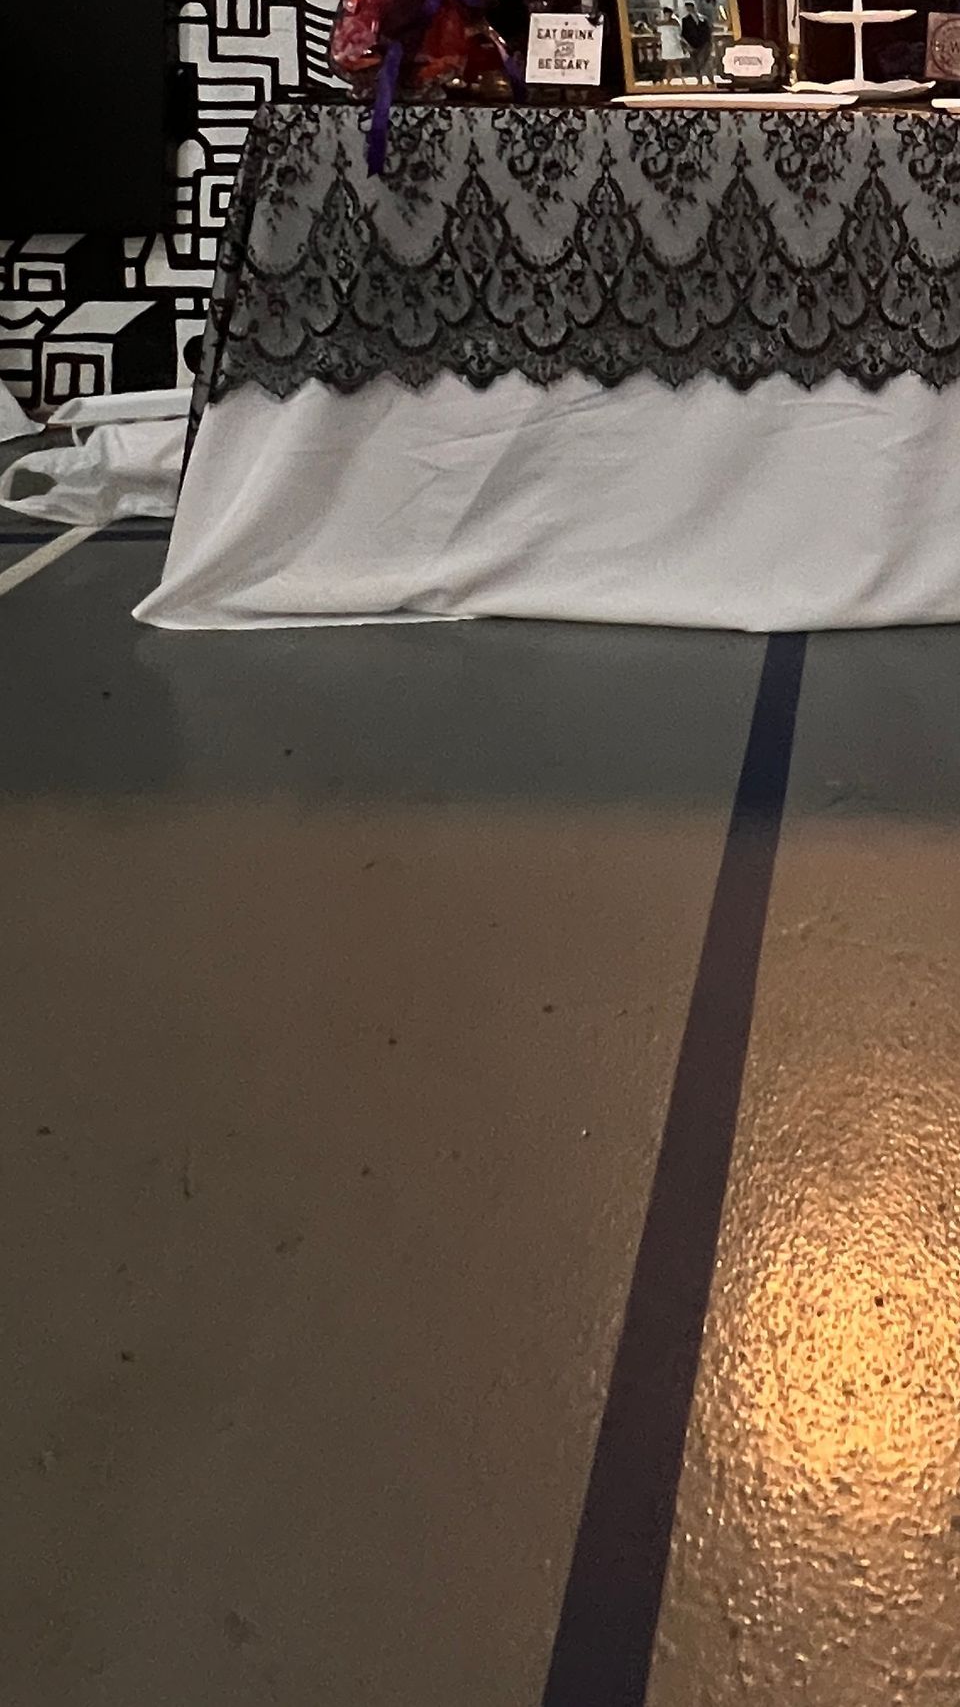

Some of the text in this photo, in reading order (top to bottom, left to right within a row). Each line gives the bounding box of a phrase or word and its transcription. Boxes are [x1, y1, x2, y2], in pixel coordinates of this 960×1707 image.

[537, 28, 594, 41] EAT DRINK
[538, 58, 590, 70] BE SCARY
